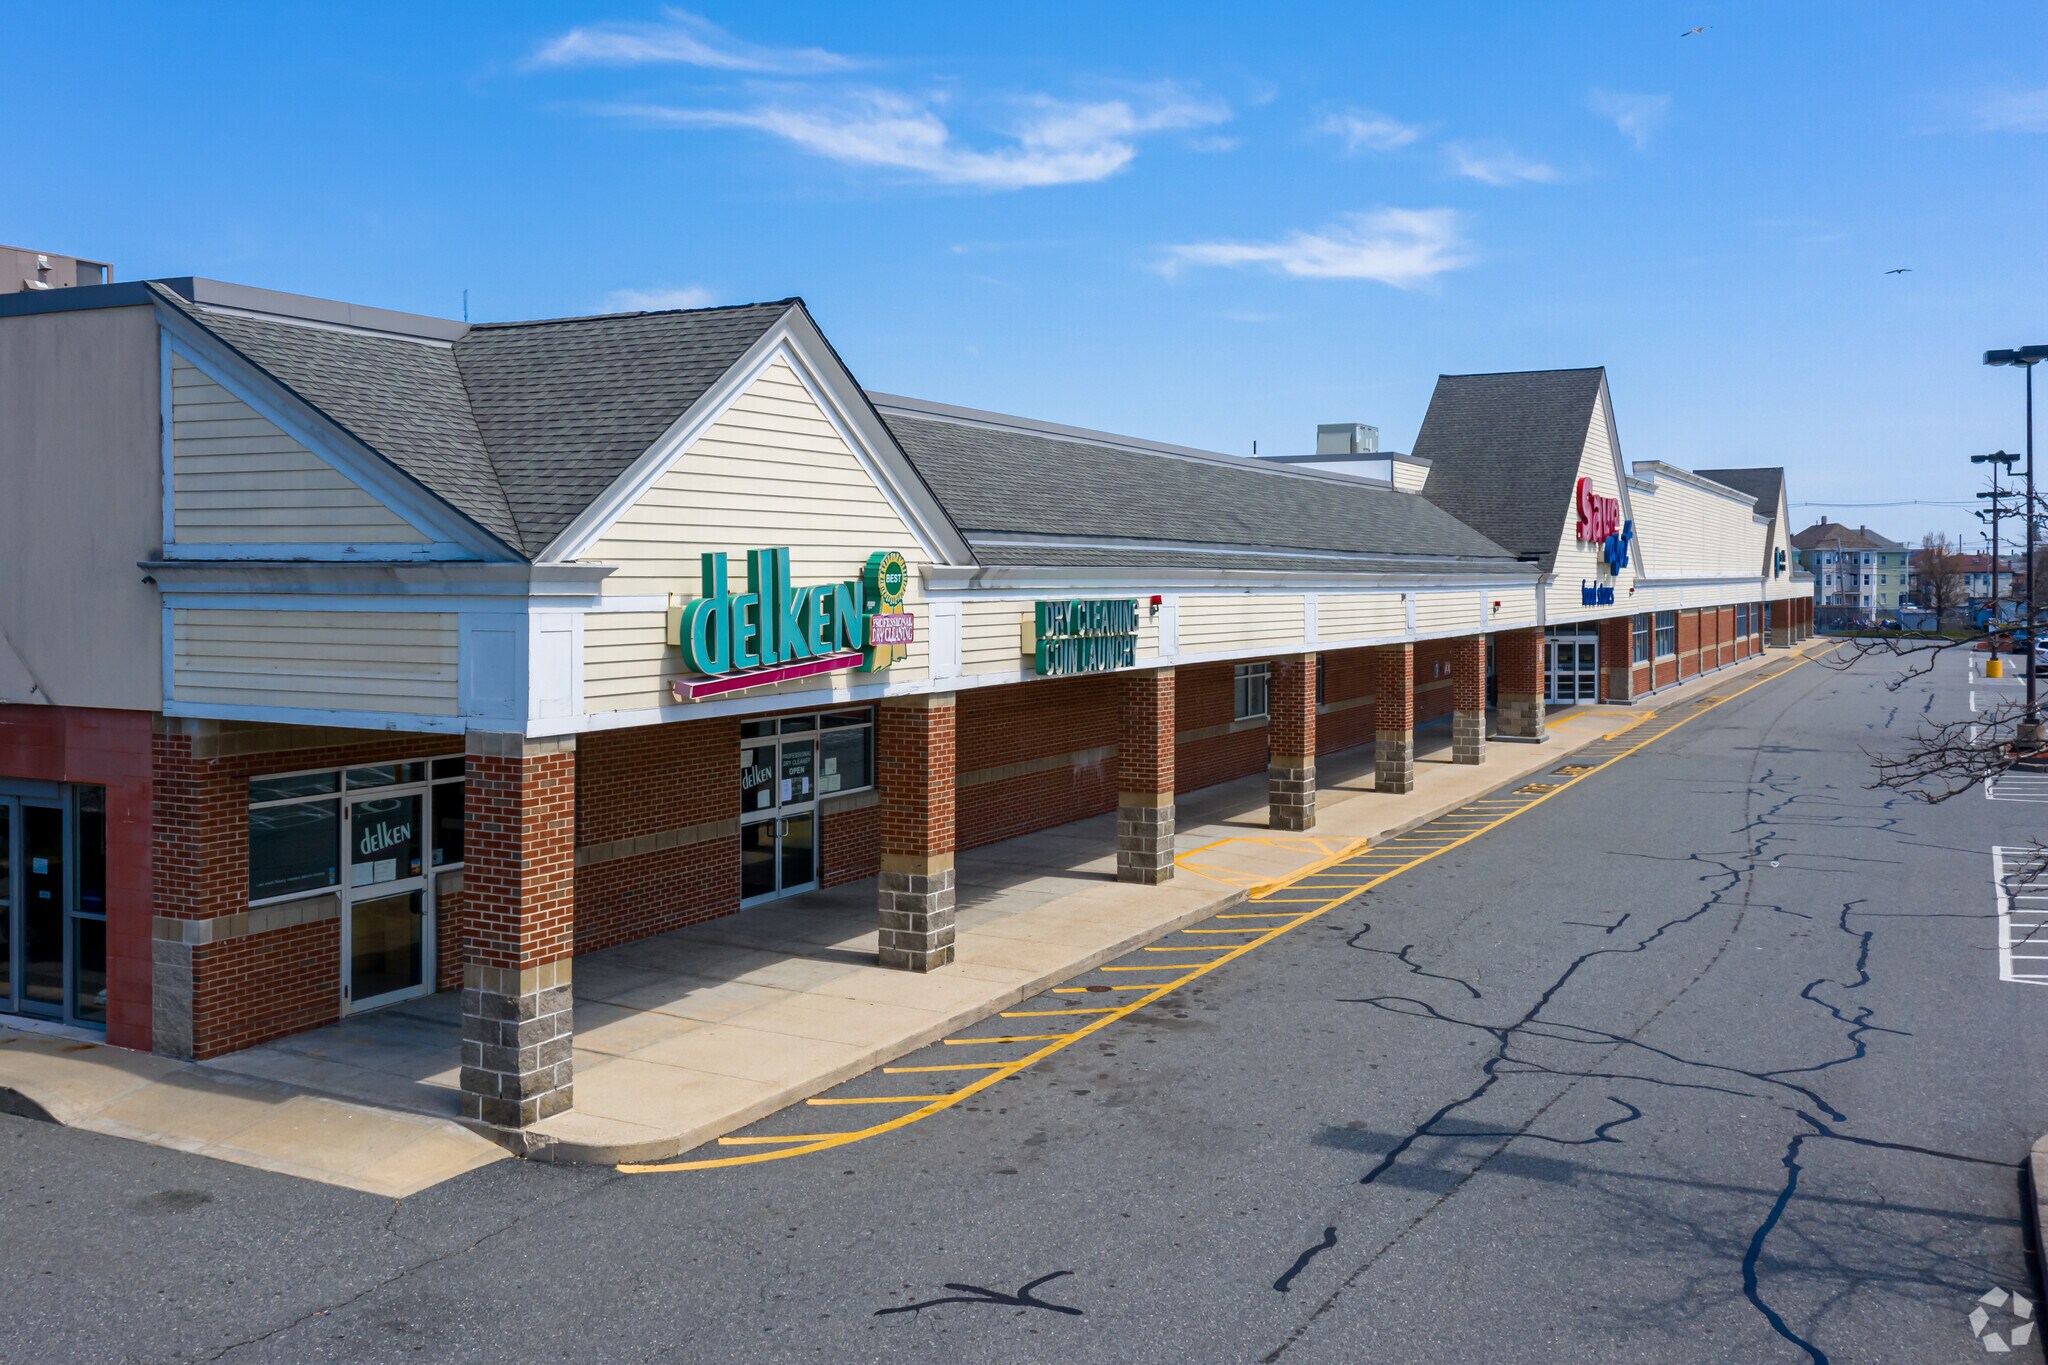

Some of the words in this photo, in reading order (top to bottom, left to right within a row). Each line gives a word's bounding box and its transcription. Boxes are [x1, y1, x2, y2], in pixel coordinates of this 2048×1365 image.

[885, 573, 902, 583] BEST
[1043, 600, 1073, 637] DRY
[1076, 599, 1140, 637] CLEANING
[872, 627, 884, 642] DRY
[885, 627, 912, 641] CLEANING
[1043, 639, 1079, 676] COIN
[1081, 635, 1137, 672] LAUNDRY
[789, 766, 805, 776] OPEN
